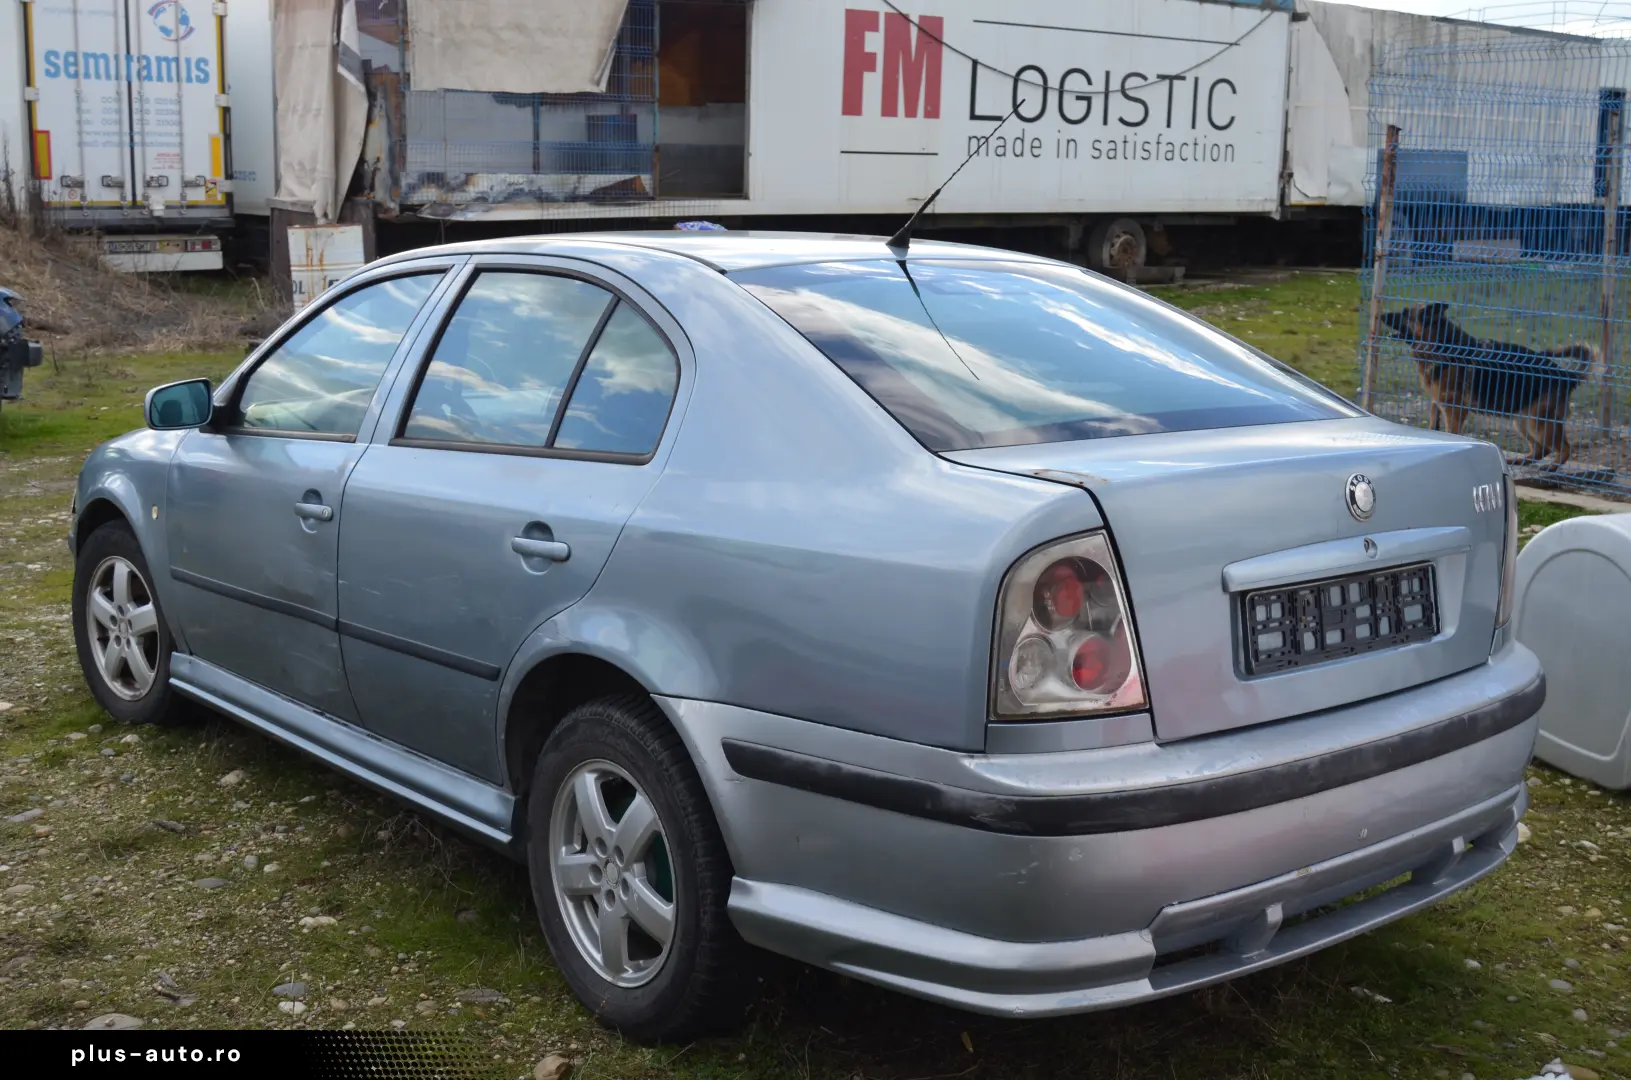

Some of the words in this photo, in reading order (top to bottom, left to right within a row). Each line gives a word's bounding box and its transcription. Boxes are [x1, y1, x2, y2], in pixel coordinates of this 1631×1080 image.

[44, 49, 211, 84] semiramis
[841, 8, 944, 120] FM
[969, 58, 1237, 131] LOGISTIC
[967, 127, 1042, 158] made
[1056, 129, 1078, 159] in
[1091, 131, 1236, 163] satisfaction
